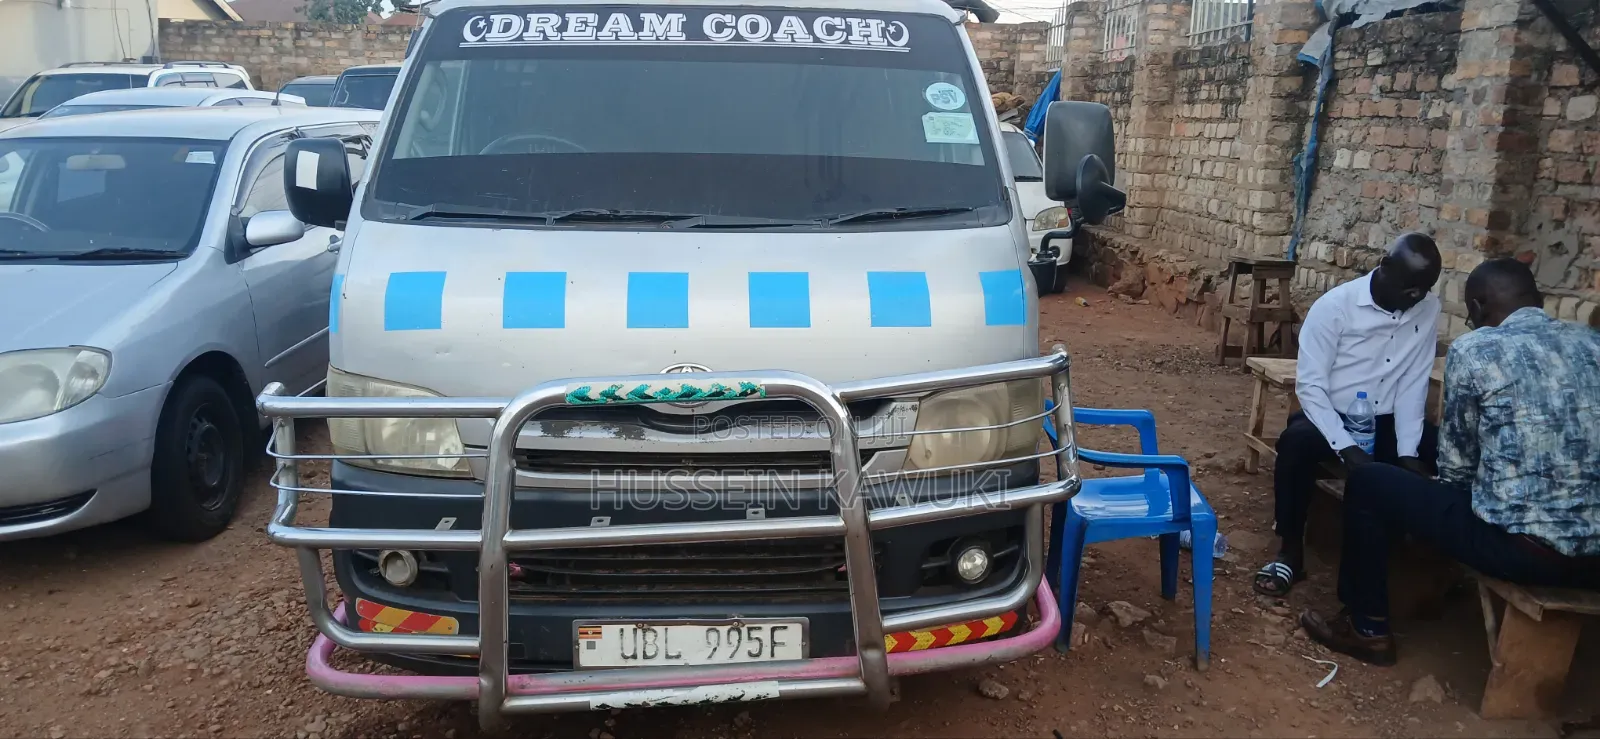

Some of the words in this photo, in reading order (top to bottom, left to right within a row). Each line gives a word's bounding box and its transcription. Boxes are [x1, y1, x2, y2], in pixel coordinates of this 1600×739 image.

[484, 12, 687, 43] DREAM
[702, 13, 889, 45] COACH
[619, 626, 682, 660] UBL
[705, 625, 788, 659] 995F
